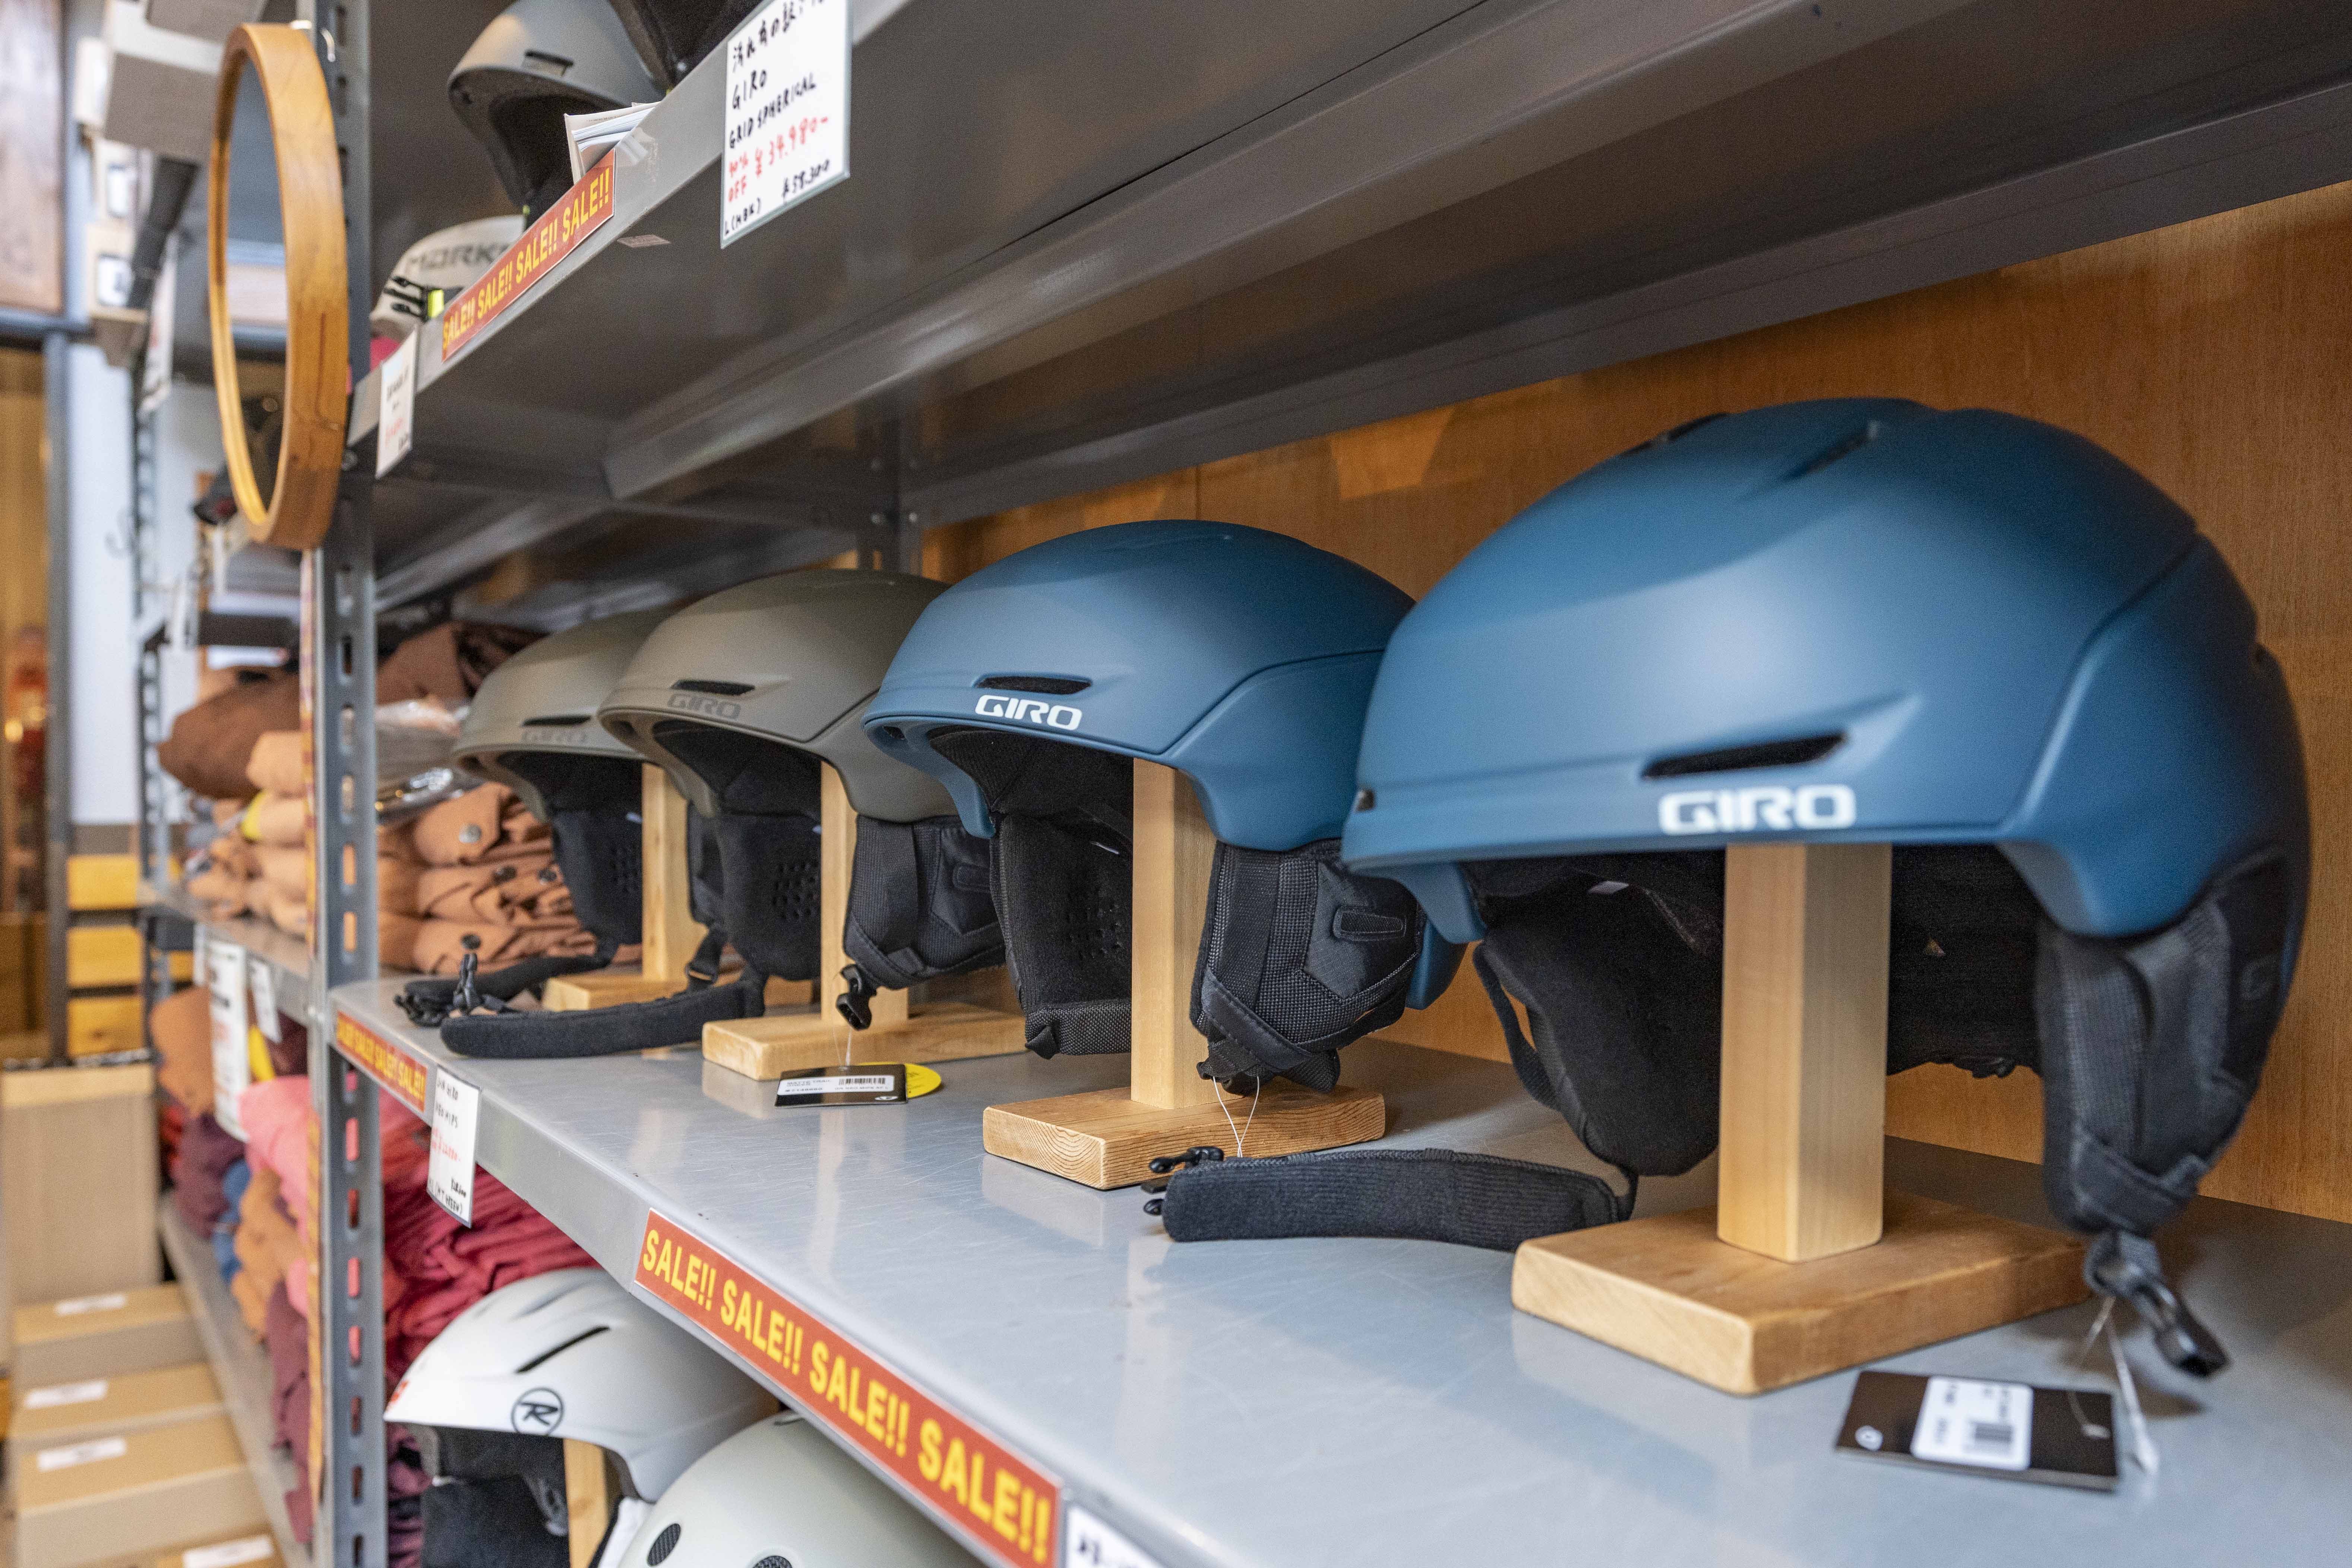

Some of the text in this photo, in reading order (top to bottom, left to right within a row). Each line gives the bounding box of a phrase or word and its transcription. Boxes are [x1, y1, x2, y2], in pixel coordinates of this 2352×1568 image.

[730, 73, 816, 149] GRID SPHERICAL
[733, 70, 767, 110] GIRO
[443, 298, 475, 349] SALE!!
[477, 262, 513, 319] SALE!!
[516, 218, 558, 284] SALE!!
[562, 168, 610, 242] SALE!!
[667, 693, 741, 720] GIRO
[975, 695, 1082, 731] GIRO
[1658, 784, 1856, 835] GIRO
[642, 1229, 1050, 1564] SALE!! SALE!! SALE!! SALE!!
